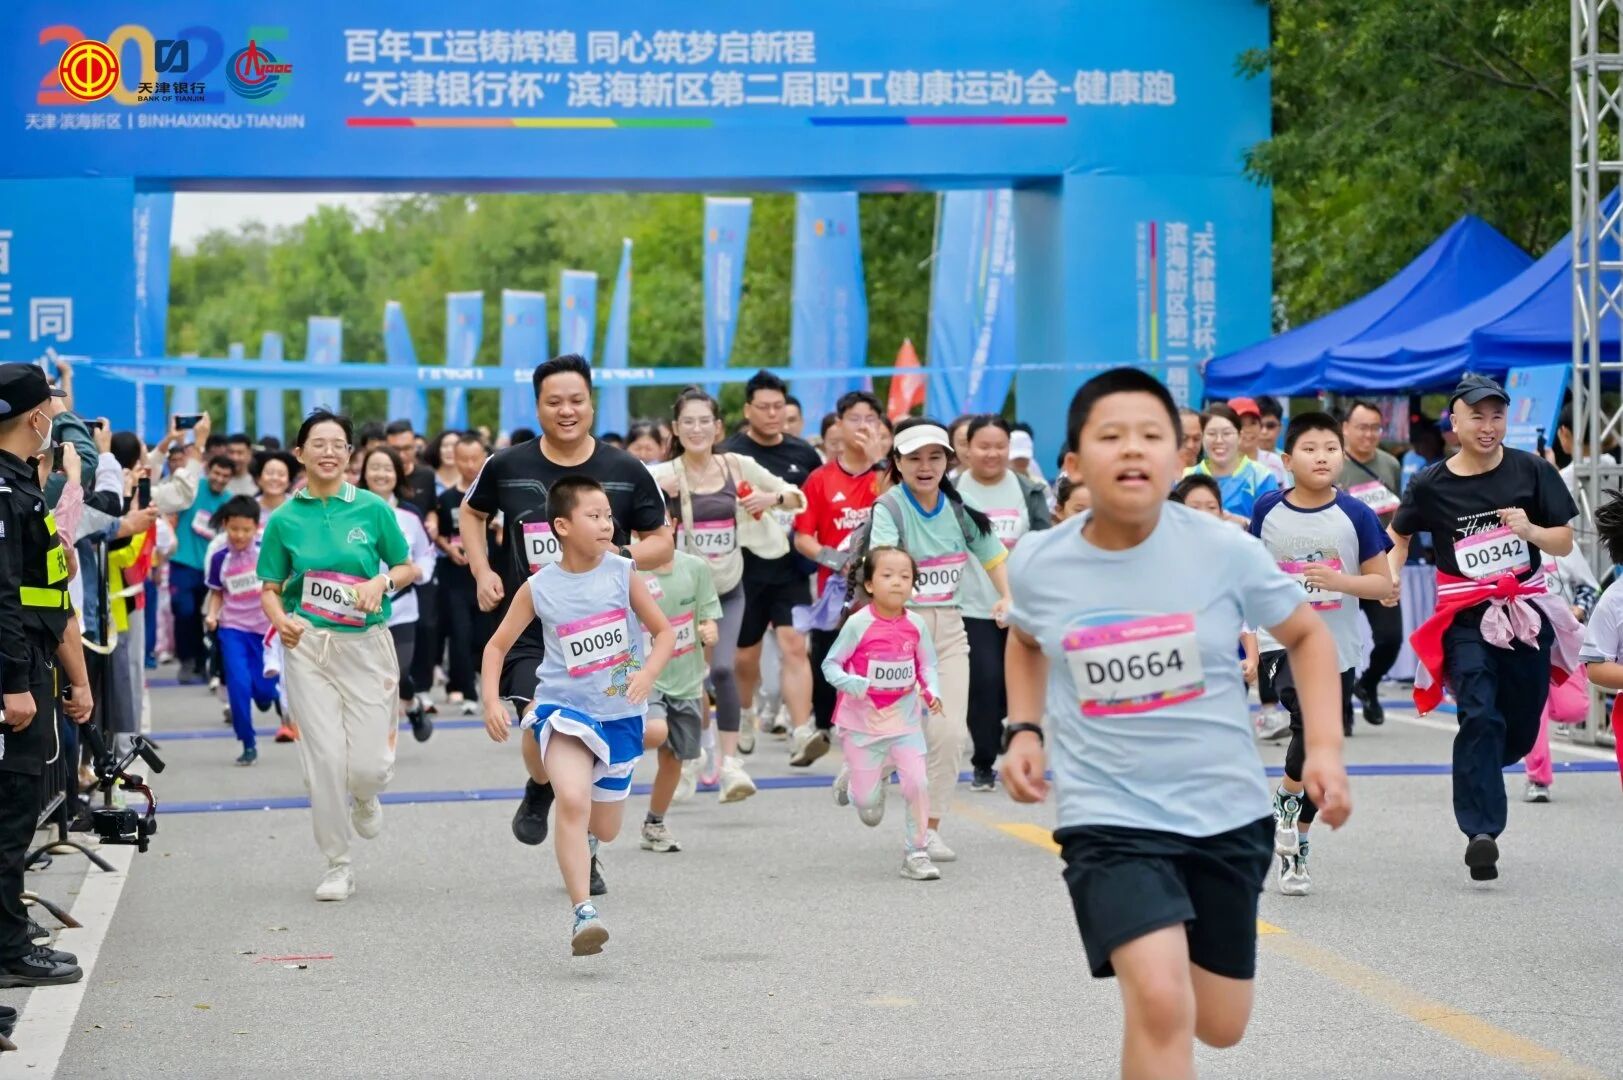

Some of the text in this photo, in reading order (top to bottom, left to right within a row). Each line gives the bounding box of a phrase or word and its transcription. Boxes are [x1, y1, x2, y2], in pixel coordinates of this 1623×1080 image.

[344, 29, 816, 64] 百年工运铸辉煌 同心筑梦启新程
[532, 538, 563, 555] D0
[1465, 539, 1523, 569] D0342
[570, 628, 622, 657] D0096
[875, 665, 913, 681] D0003
[1085, 648, 1184, 685] D0664
